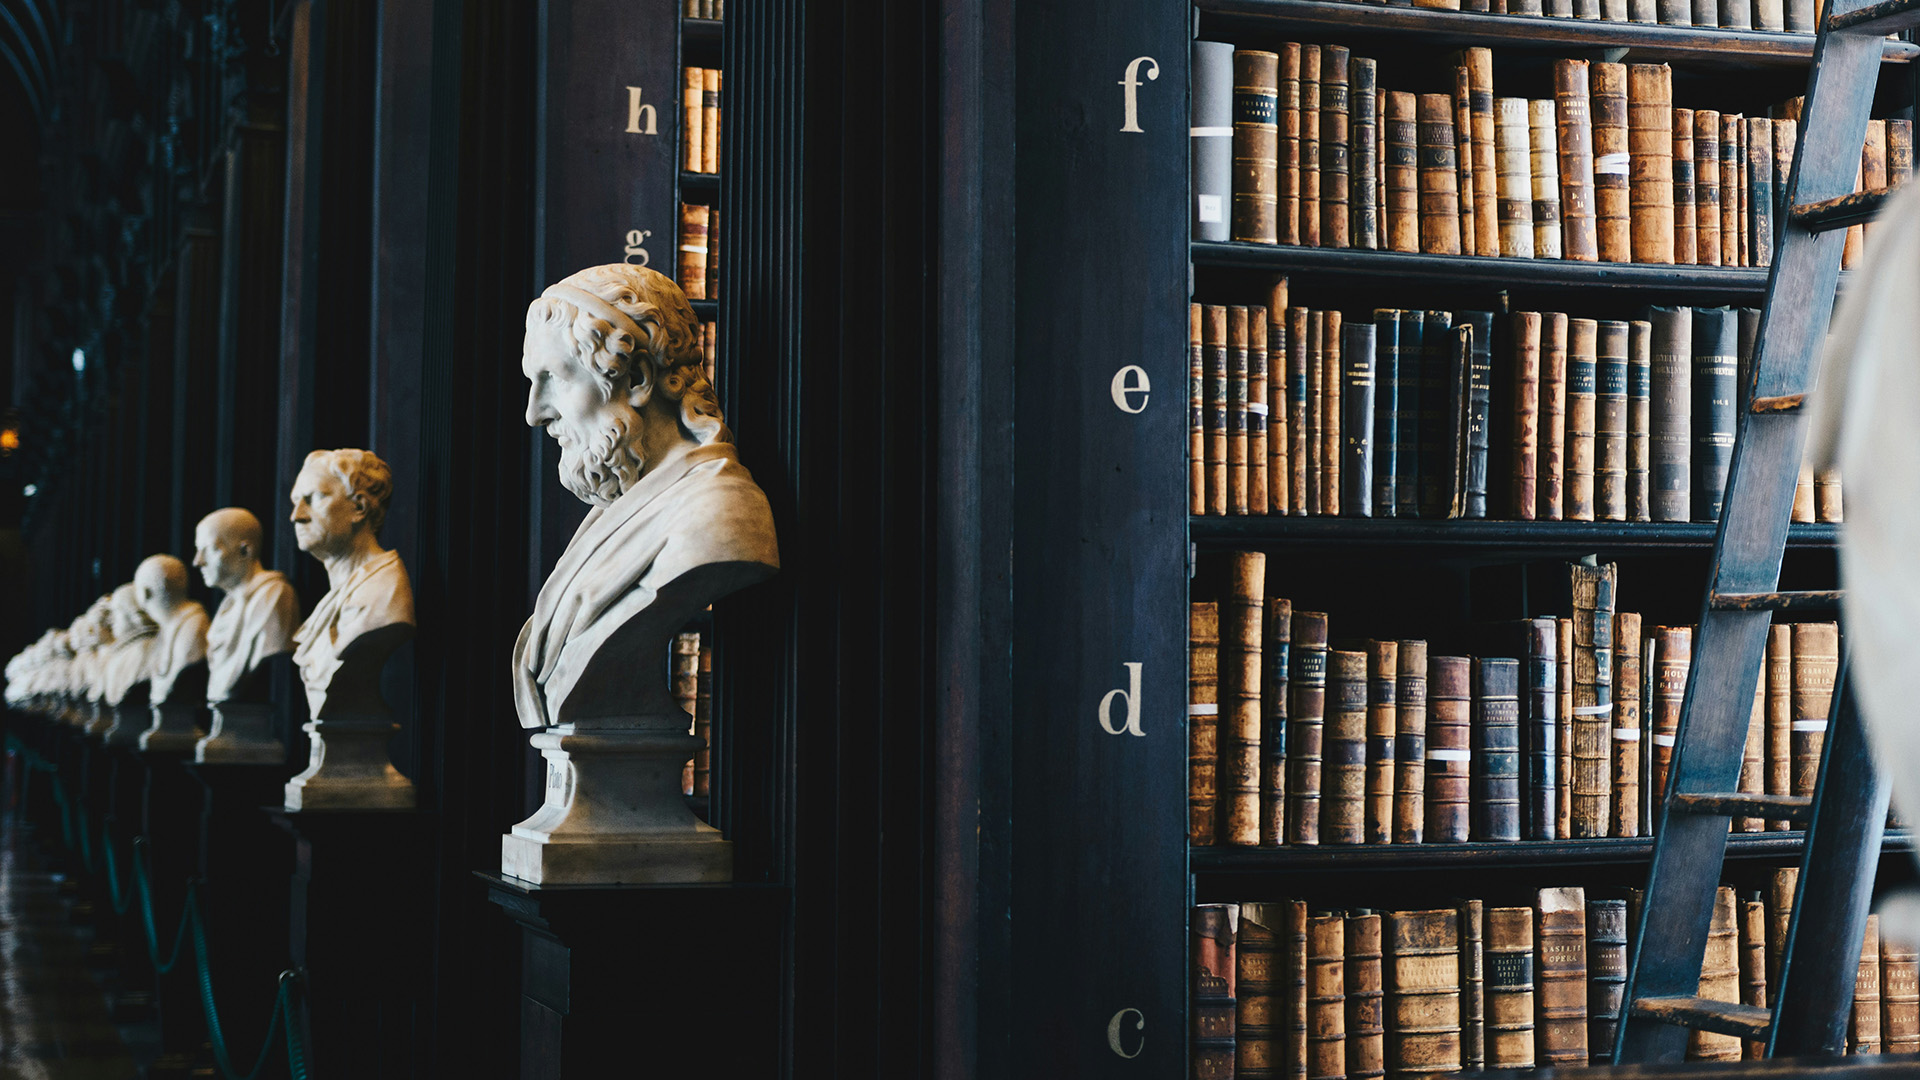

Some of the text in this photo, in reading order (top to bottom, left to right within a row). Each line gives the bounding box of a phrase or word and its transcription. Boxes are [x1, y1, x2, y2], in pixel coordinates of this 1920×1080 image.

[625, 86, 658, 135] h
[1118, 57, 1160, 133] f
[624, 230, 652, 267] g
[1111, 365, 1151, 414] e
[1098, 662, 1147, 737] d
[1660, 681, 1685, 689] BIBL
[1549, 954, 1577, 963] OPERA
[1891, 969, 1912, 977] HOLY
[1889, 981, 1915, 990] BIBLE
[1108, 1007, 1145, 1059] c
